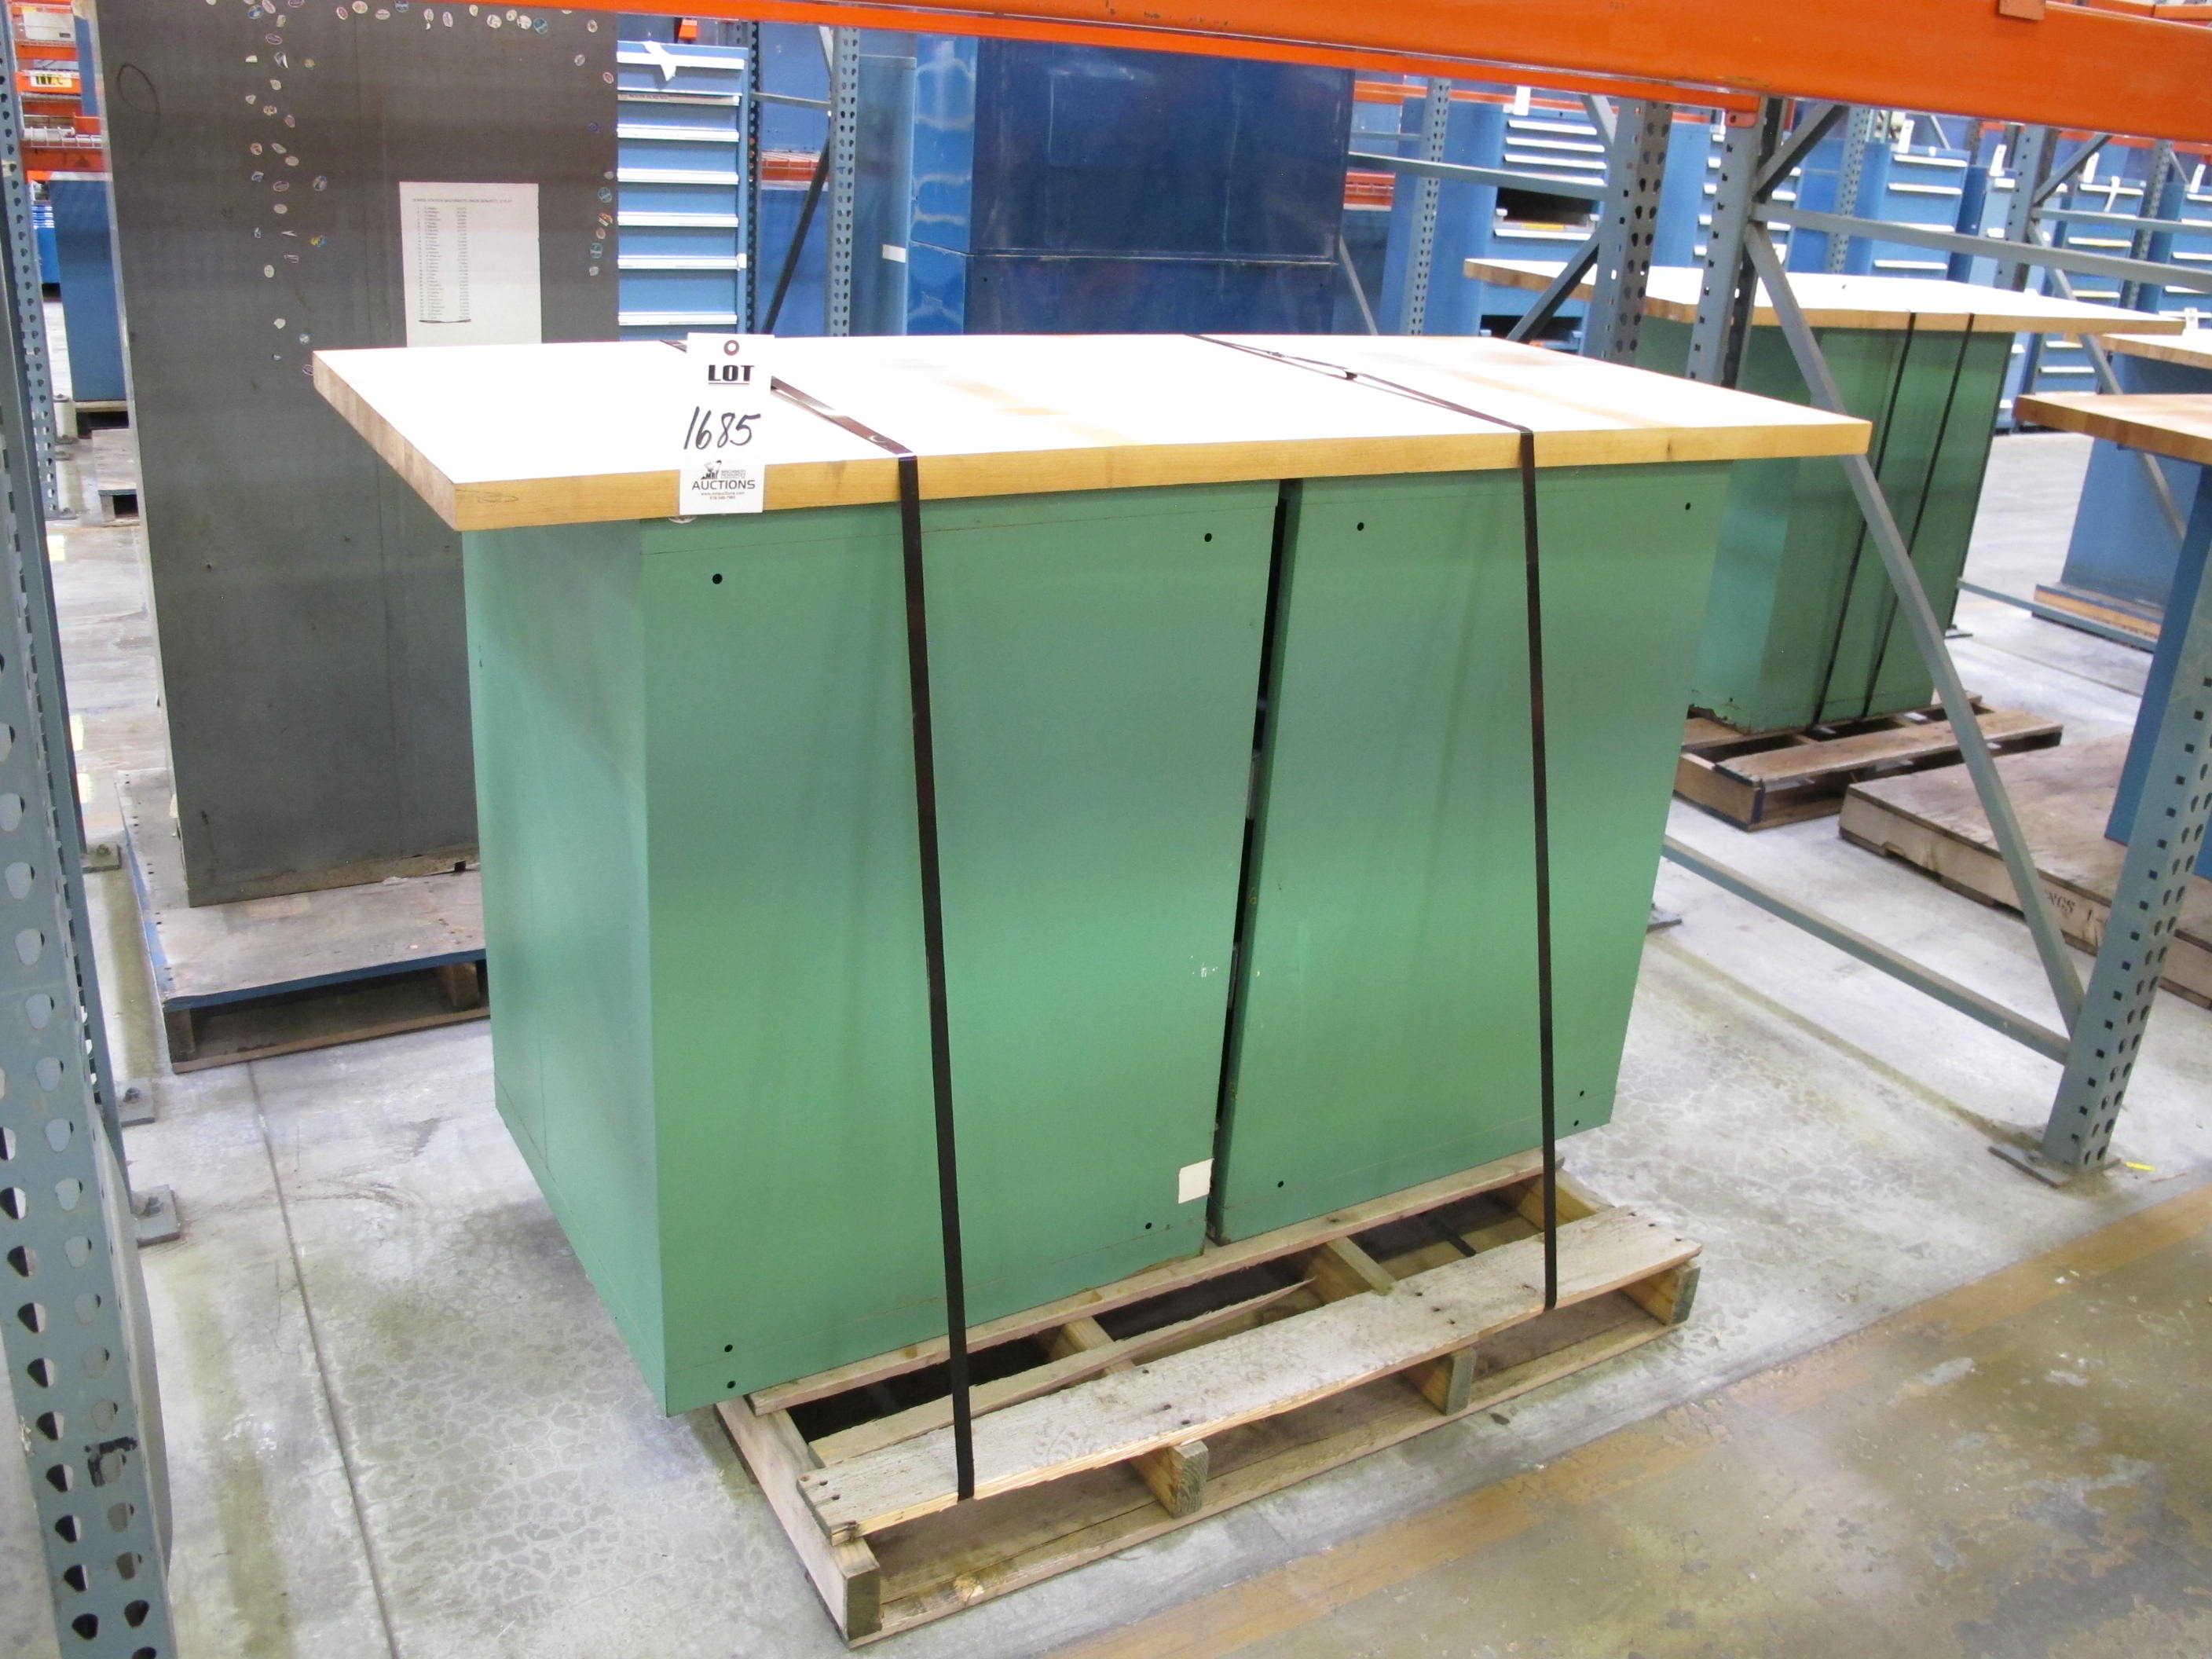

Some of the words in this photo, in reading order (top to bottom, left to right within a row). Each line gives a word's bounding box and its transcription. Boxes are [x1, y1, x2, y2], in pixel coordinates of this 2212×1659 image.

[708, 364, 755, 382] LOT
[683, 405, 761, 450] 1685
[692, 479, 756, 490] AUCTIONS
